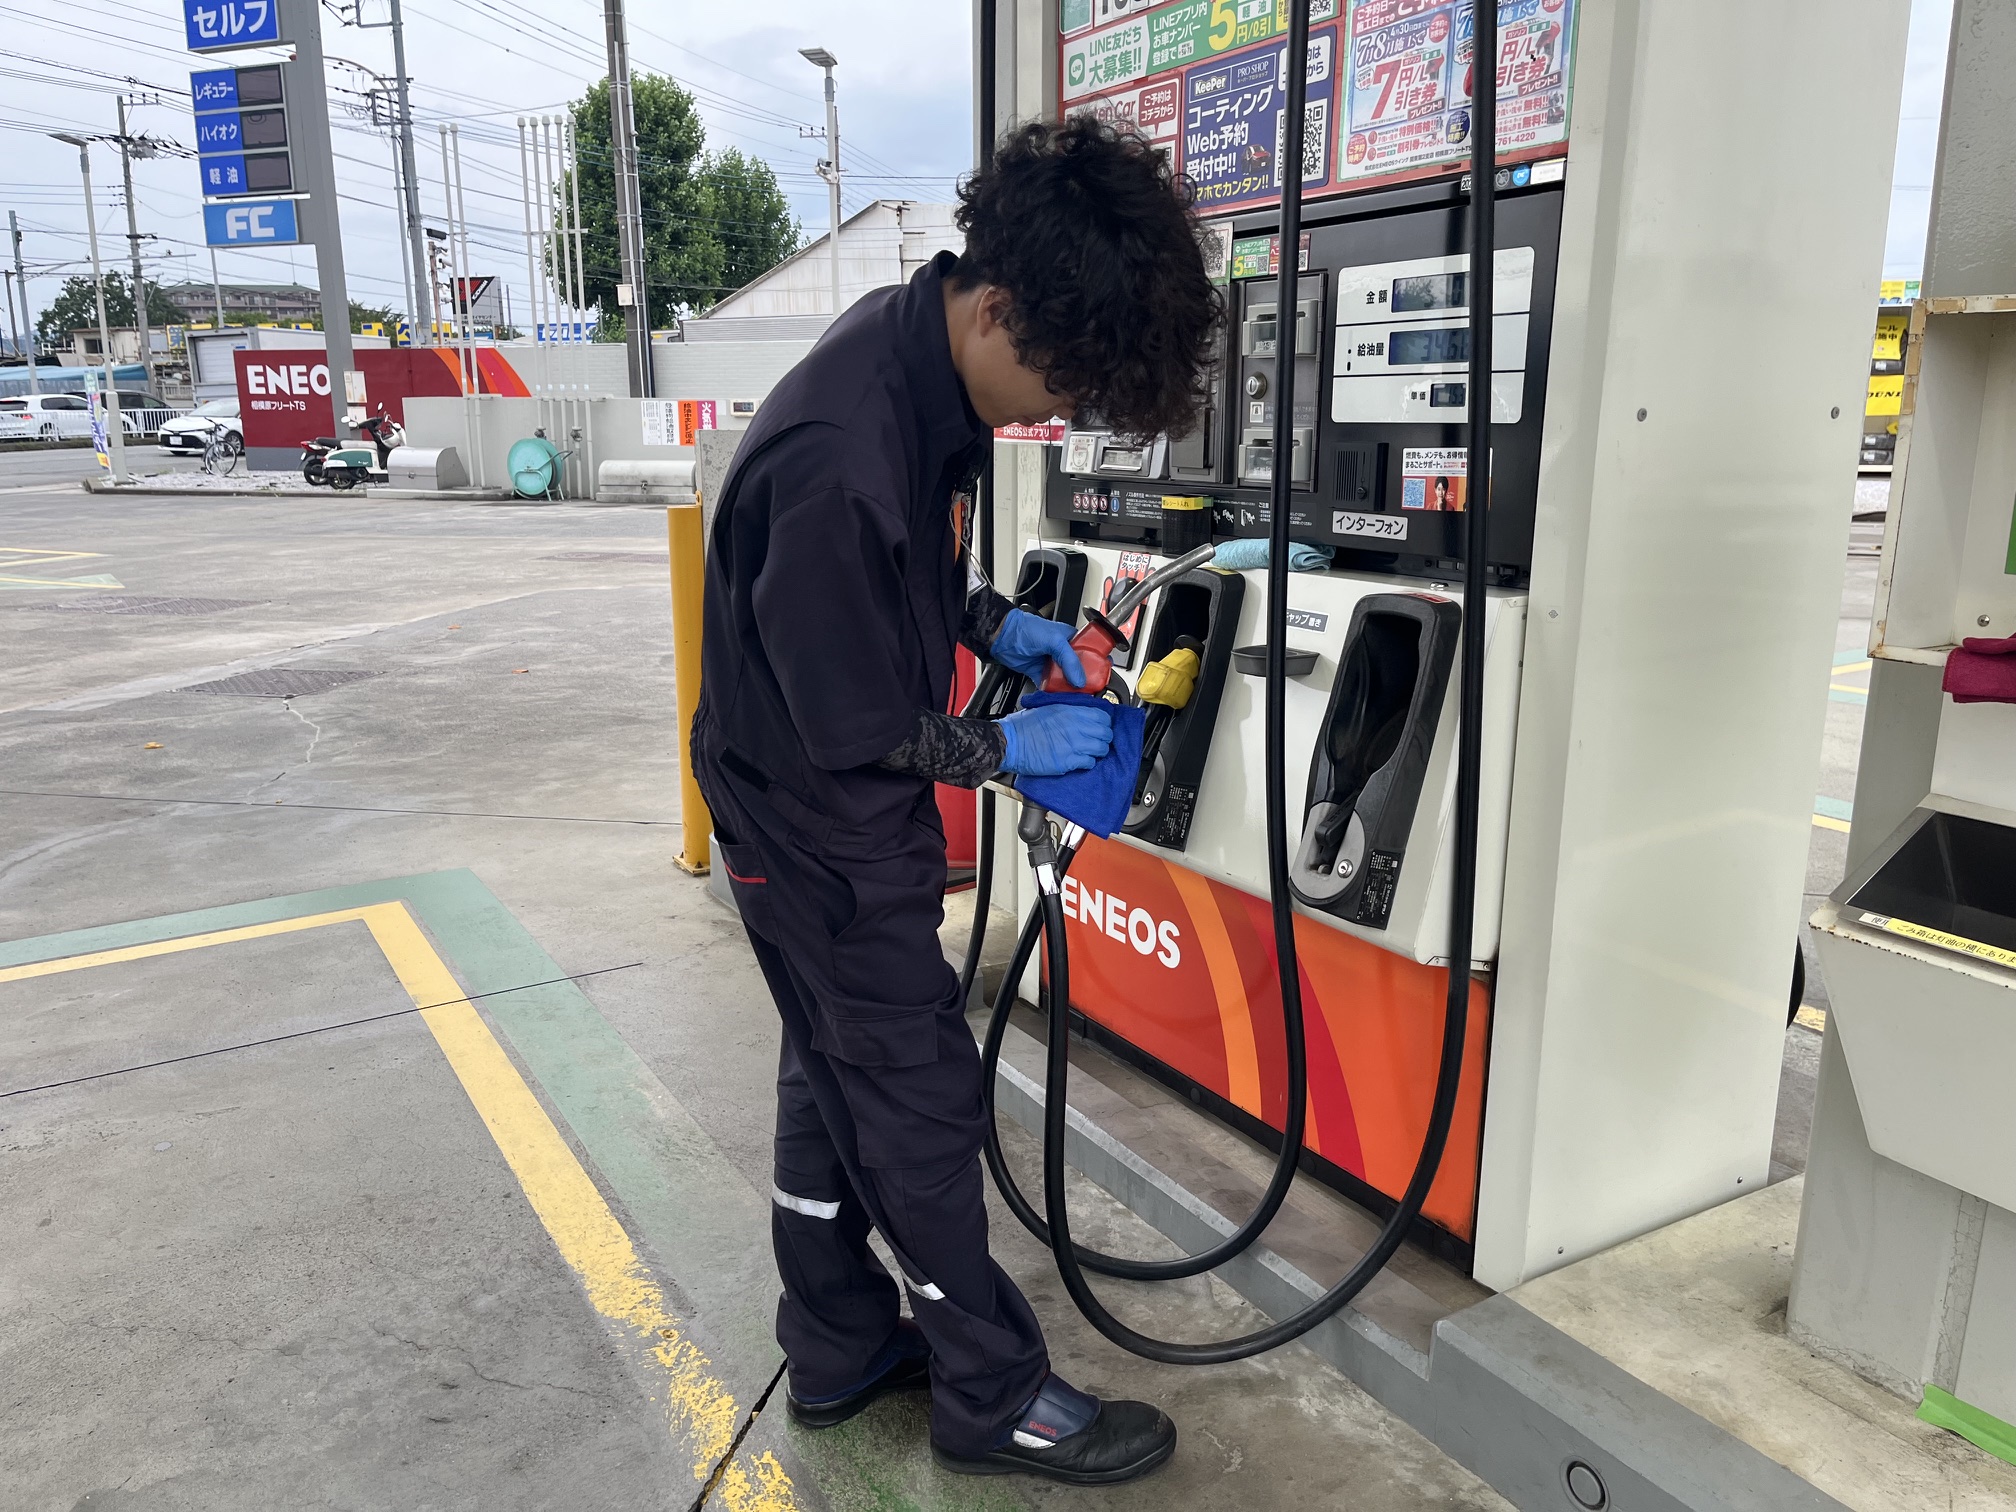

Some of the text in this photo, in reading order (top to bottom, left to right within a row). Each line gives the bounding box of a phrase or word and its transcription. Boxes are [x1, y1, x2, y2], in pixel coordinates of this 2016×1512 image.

[192, 1, 268, 39] セルフ
[1153, 1, 1208, 32] LINEアプリ内
[1208, 0, 1237, 51] 5
[1089, 26, 1142, 58] LINE友だち
[1152, 21, 1202, 49] お車ナンバー
[1152, 46, 1178, 67] 登録で
[1088, 47, 1142, 88] 大募集!!
[1237, 60, 1269, 77] PRO SHOP
[194, 81, 234, 101] レギュラー
[1193, 75, 1228, 97] KeePer
[1371, 58, 1402, 120] 7
[1521, 75, 1558, 95] プレゼント!!
[1143, 89, 1172, 107] ご予約は
[1187, 84, 1274, 129] コーティング
[1394, 81, 1438, 112] 引き券
[1140, 103, 1174, 122] コチラから
[1410, 100, 1443, 119] プレゼント!!
[200, 123, 238, 142] ハイオク
[1186, 120, 1250, 155] Web予約
[208, 166, 239, 186] 軽油
[1186, 152, 1237, 183] 受付中!!
[1193, 174, 1269, 202] マホでカンタン!!
[225, 205, 276, 240] FC
[1365, 289, 1388, 305] 金額
[1357, 342, 1384, 357] 給油量
[1003, 426, 1050, 438] ENEOS公式アプリ
[1405, 460, 1443, 469] まるごとサポート。
[1335, 515, 1404, 536] インターフォン
[1121, 562, 1146, 573] タッチ!
[1122, 553, 1149, 564] はじめに
[1061, 874, 1181, 969] ENEOS
[1028, 1420, 1057, 1438] ENEOS
